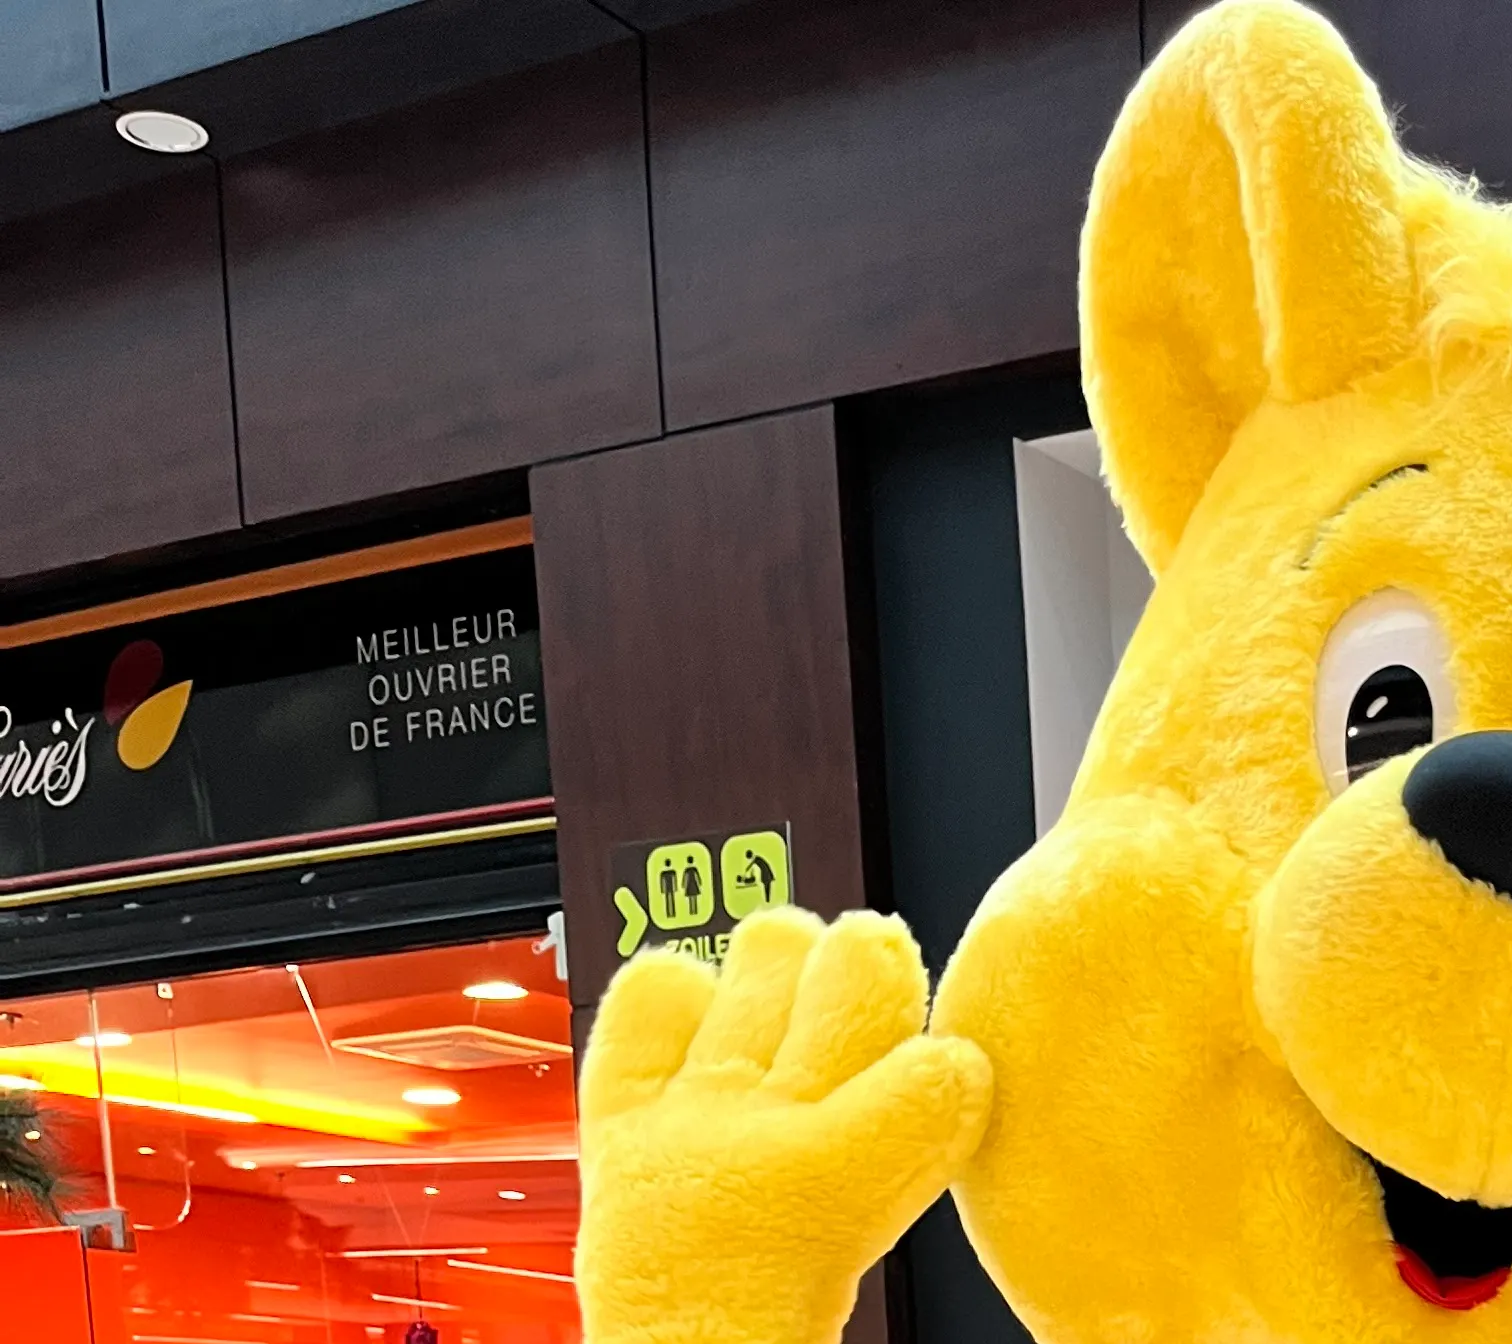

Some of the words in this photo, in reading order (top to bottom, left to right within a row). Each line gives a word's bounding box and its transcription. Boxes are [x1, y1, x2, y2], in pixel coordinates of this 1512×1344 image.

[356, 608, 517, 664] MEILLEUR
[368, 654, 512, 706] OUVRIER
[350, 717, 390, 751] DE
[406, 693, 537, 743] FRANCE
